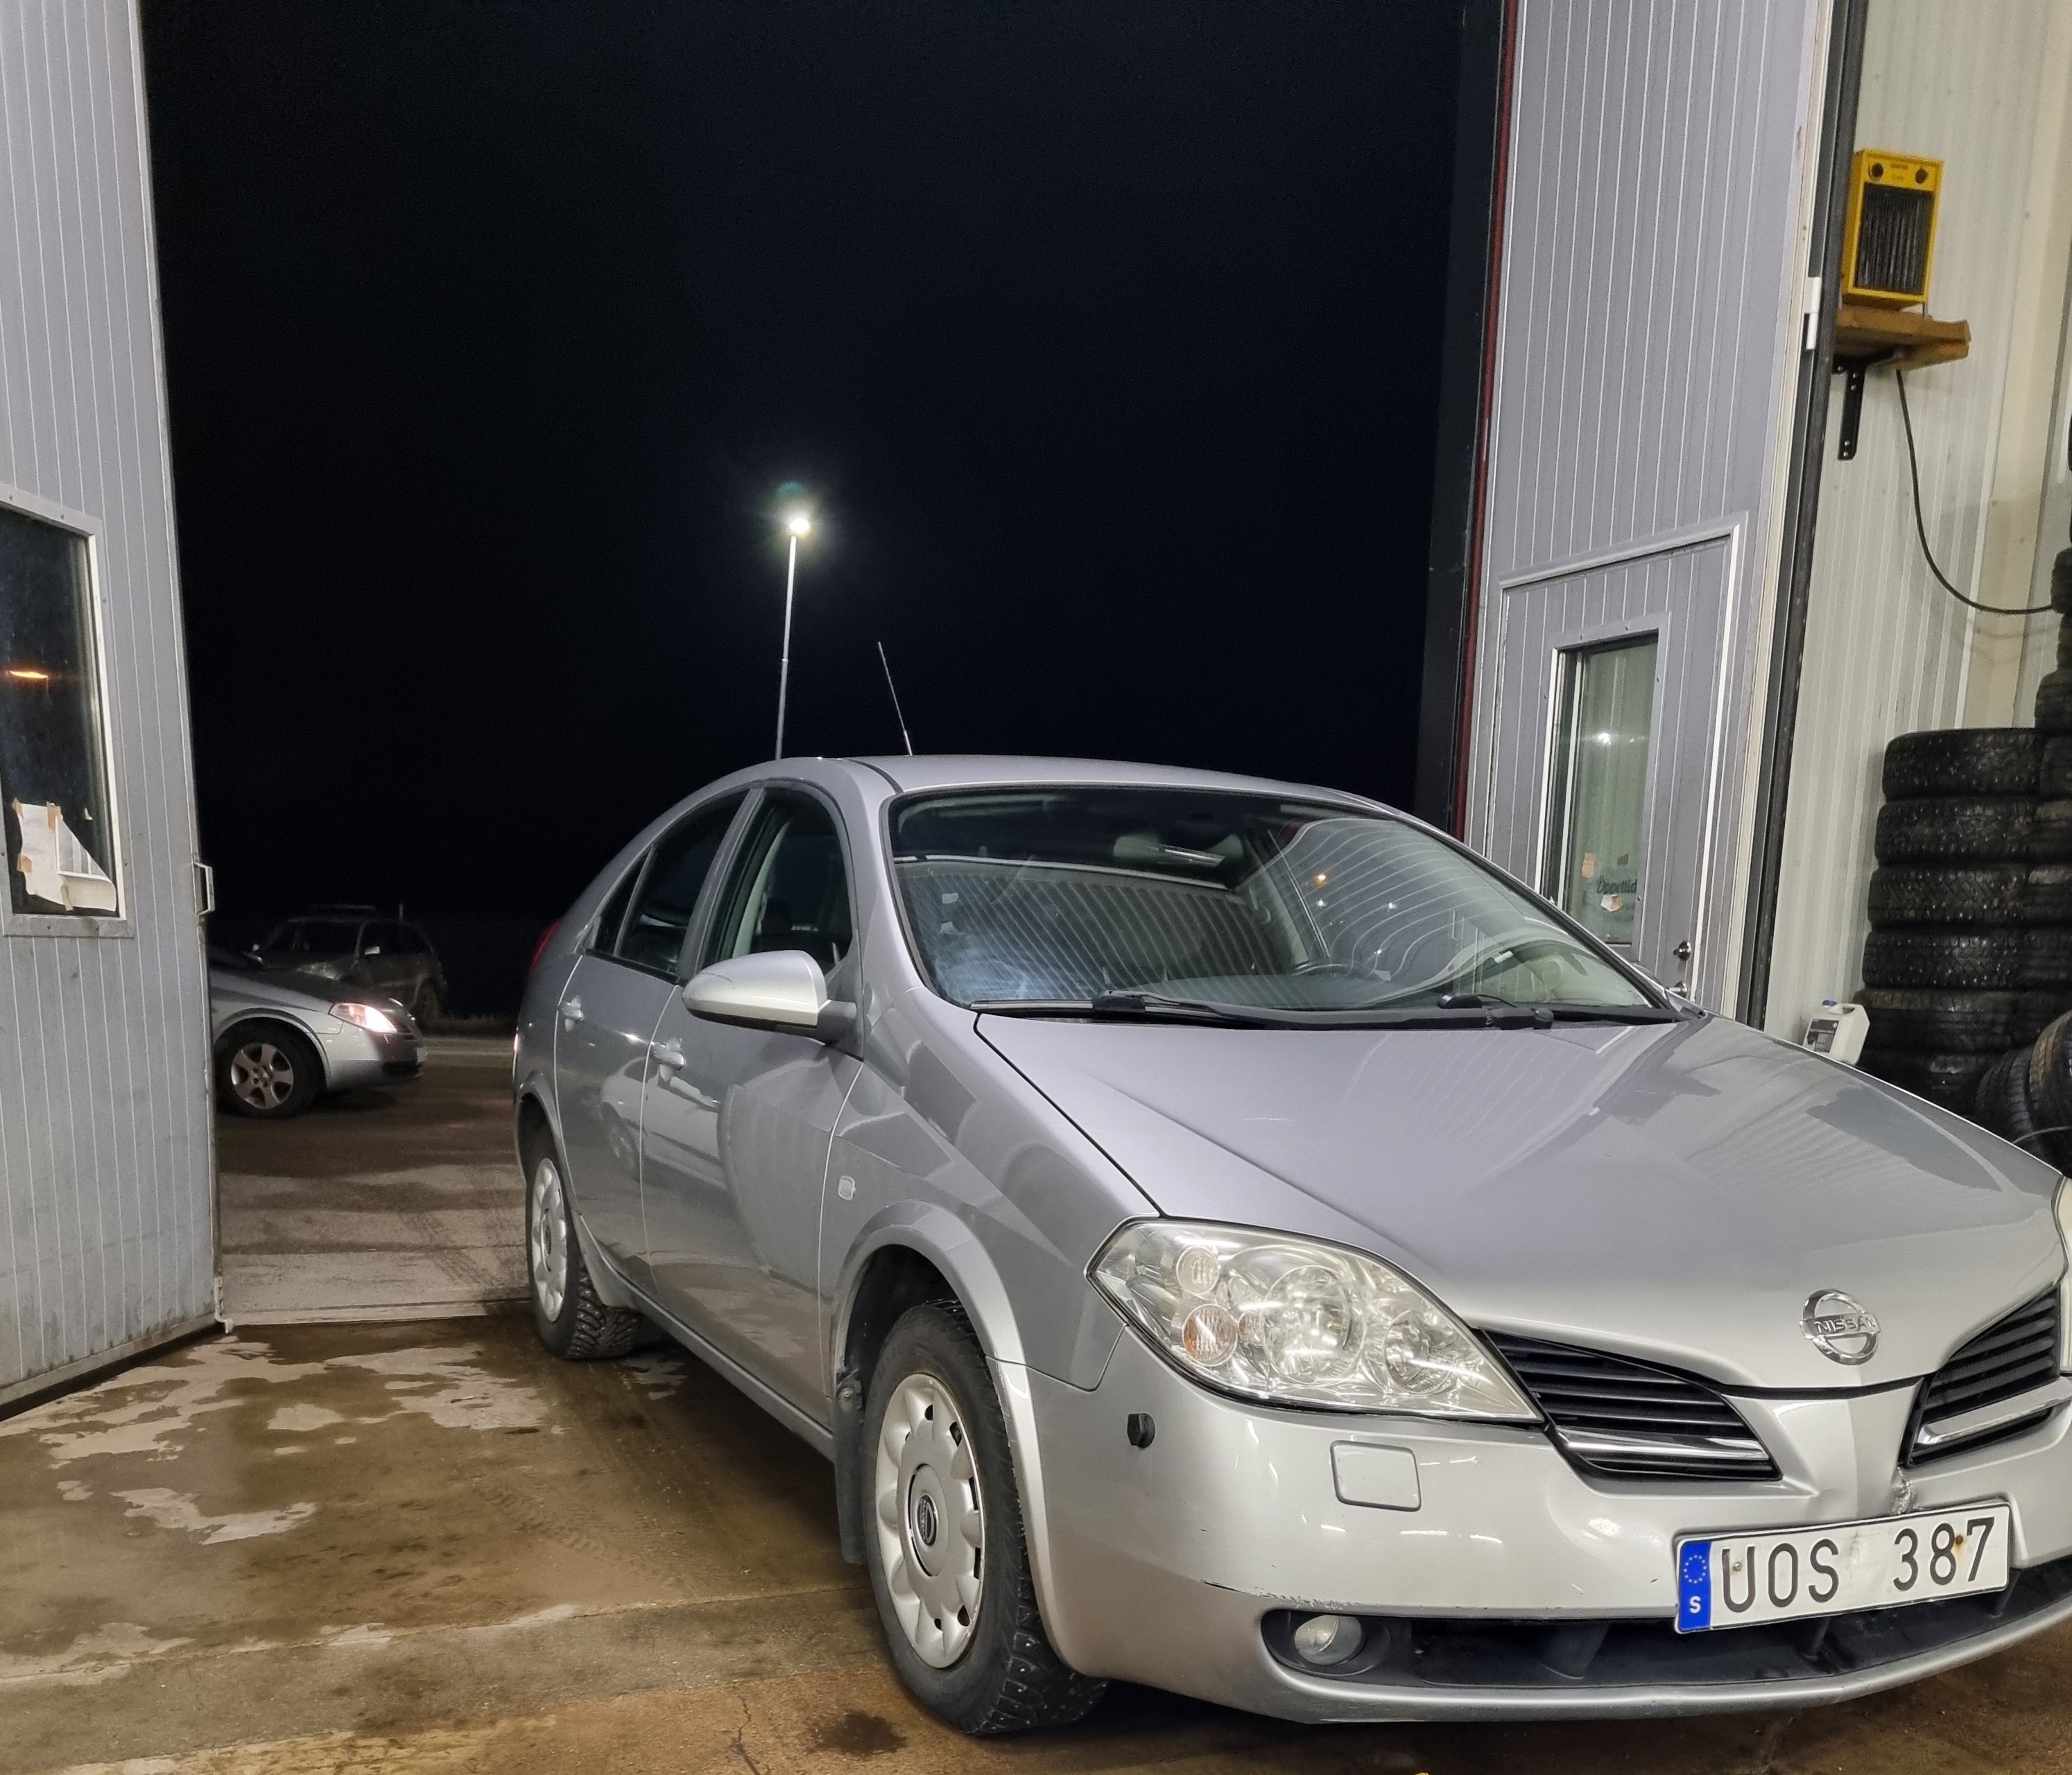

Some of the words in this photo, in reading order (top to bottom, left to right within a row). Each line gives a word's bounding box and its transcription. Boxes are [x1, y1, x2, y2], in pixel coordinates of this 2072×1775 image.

[1813, 1316, 1877, 1333] NISSAN
[1721, 1539, 1839, 1613] UOS
[1893, 1517, 1995, 1591] 387
[1689, 1595, 1701, 1613] S
